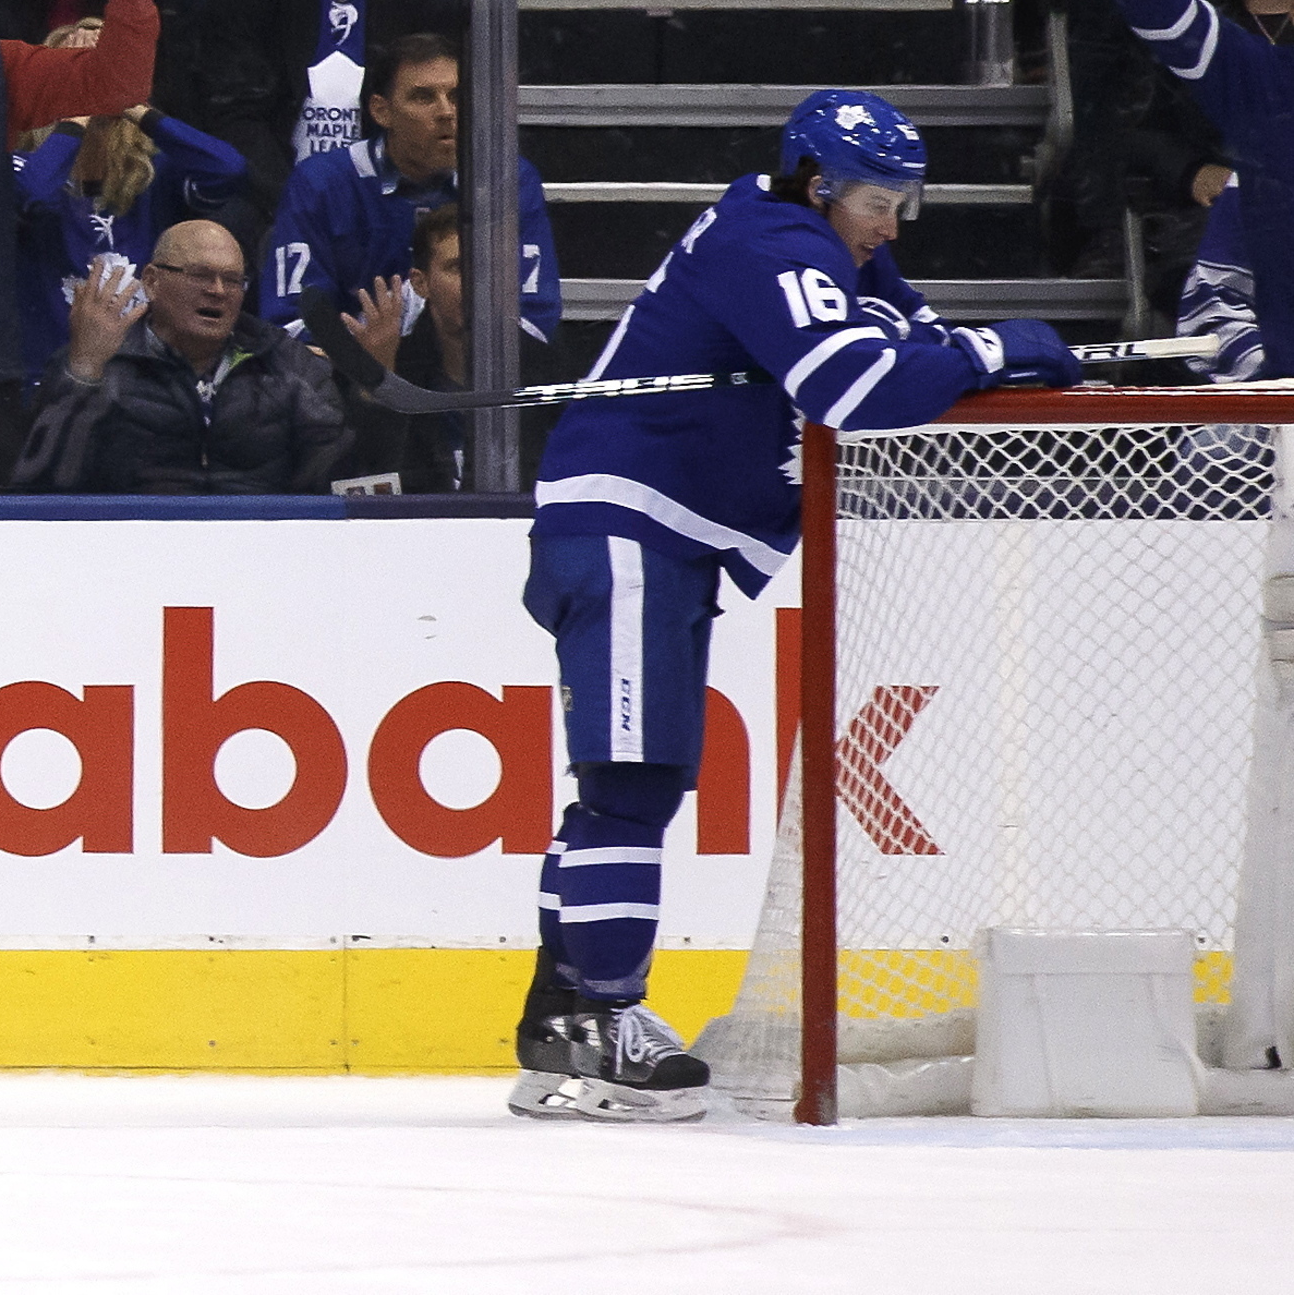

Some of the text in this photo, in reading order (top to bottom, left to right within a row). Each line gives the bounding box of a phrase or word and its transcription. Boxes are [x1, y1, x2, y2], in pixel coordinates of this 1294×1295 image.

[302, 107, 361, 122] ORONT
[275, 241, 312, 298] 17
[777, 267, 849, 329] 16
